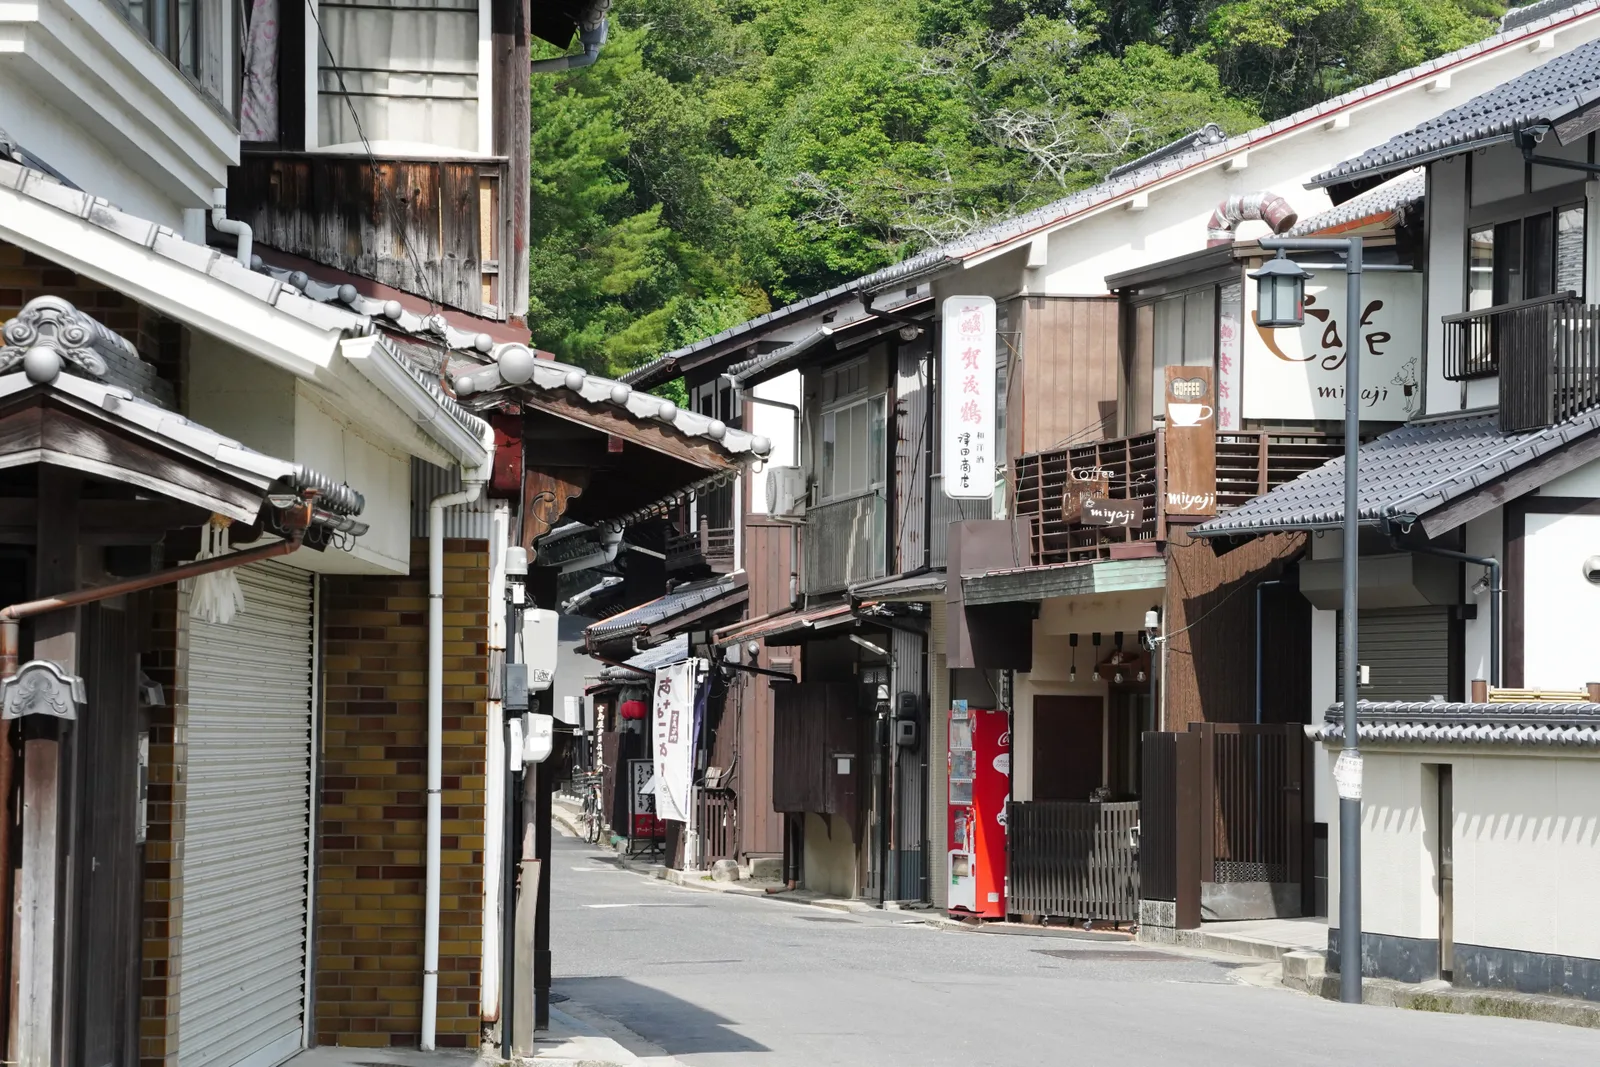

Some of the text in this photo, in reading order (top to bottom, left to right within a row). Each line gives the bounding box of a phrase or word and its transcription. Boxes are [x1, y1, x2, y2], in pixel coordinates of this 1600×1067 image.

[960, 347, 982, 425] 賀茂鶴
[1173, 382, 1200, 396] COFFEE
[1317, 385, 1388, 407] miaji
[1071, 466, 1115, 482] Coffee
[1167, 491, 1214, 510] miyaji
[1090, 507, 1135, 525] miyaji
